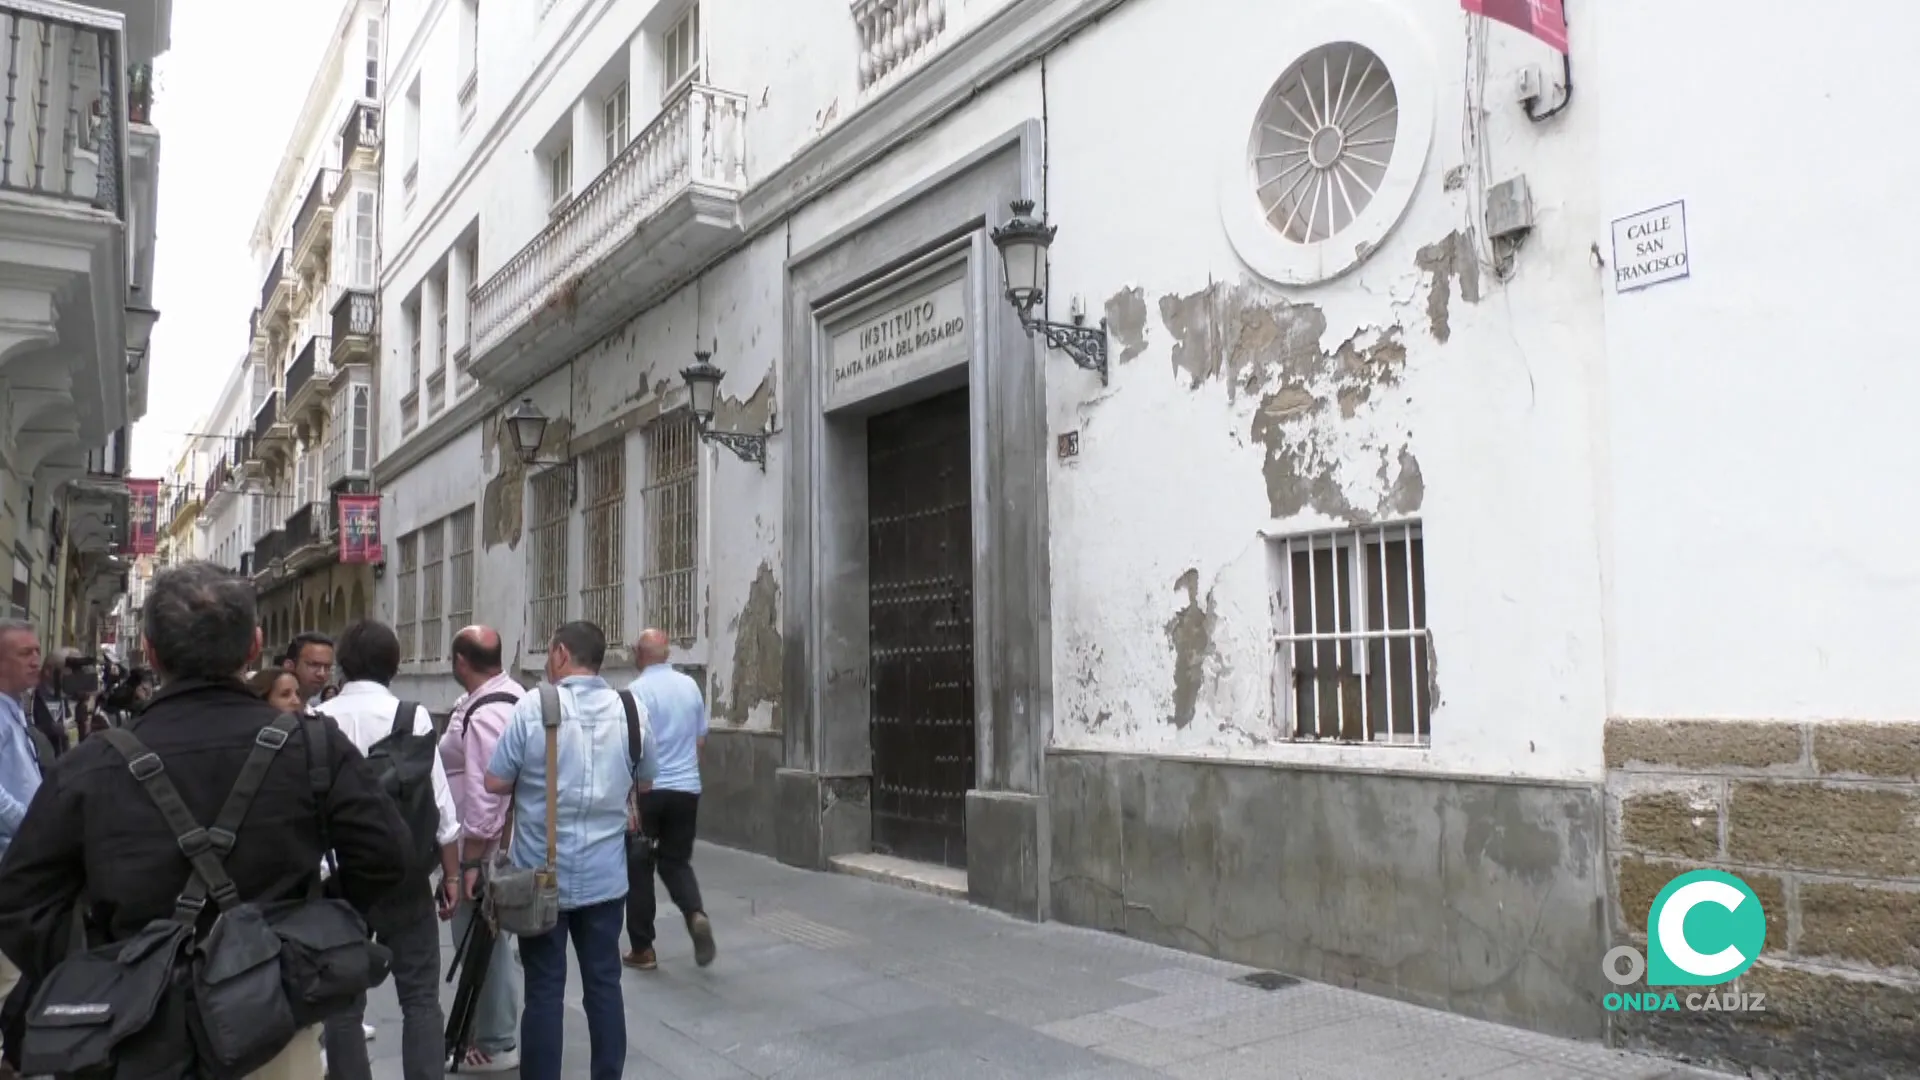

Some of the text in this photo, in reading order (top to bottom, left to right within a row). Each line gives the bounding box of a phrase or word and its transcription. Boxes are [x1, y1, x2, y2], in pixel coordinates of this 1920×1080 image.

[1627, 215, 1671, 240] CALLE
[1636, 236, 1664, 257] SAN
[1616, 252, 1686, 282] FRANCISCO
[859, 300, 934, 351] INSTITUTO
[835, 317, 964, 382] SANTA MARIA DEL ROSARIO
